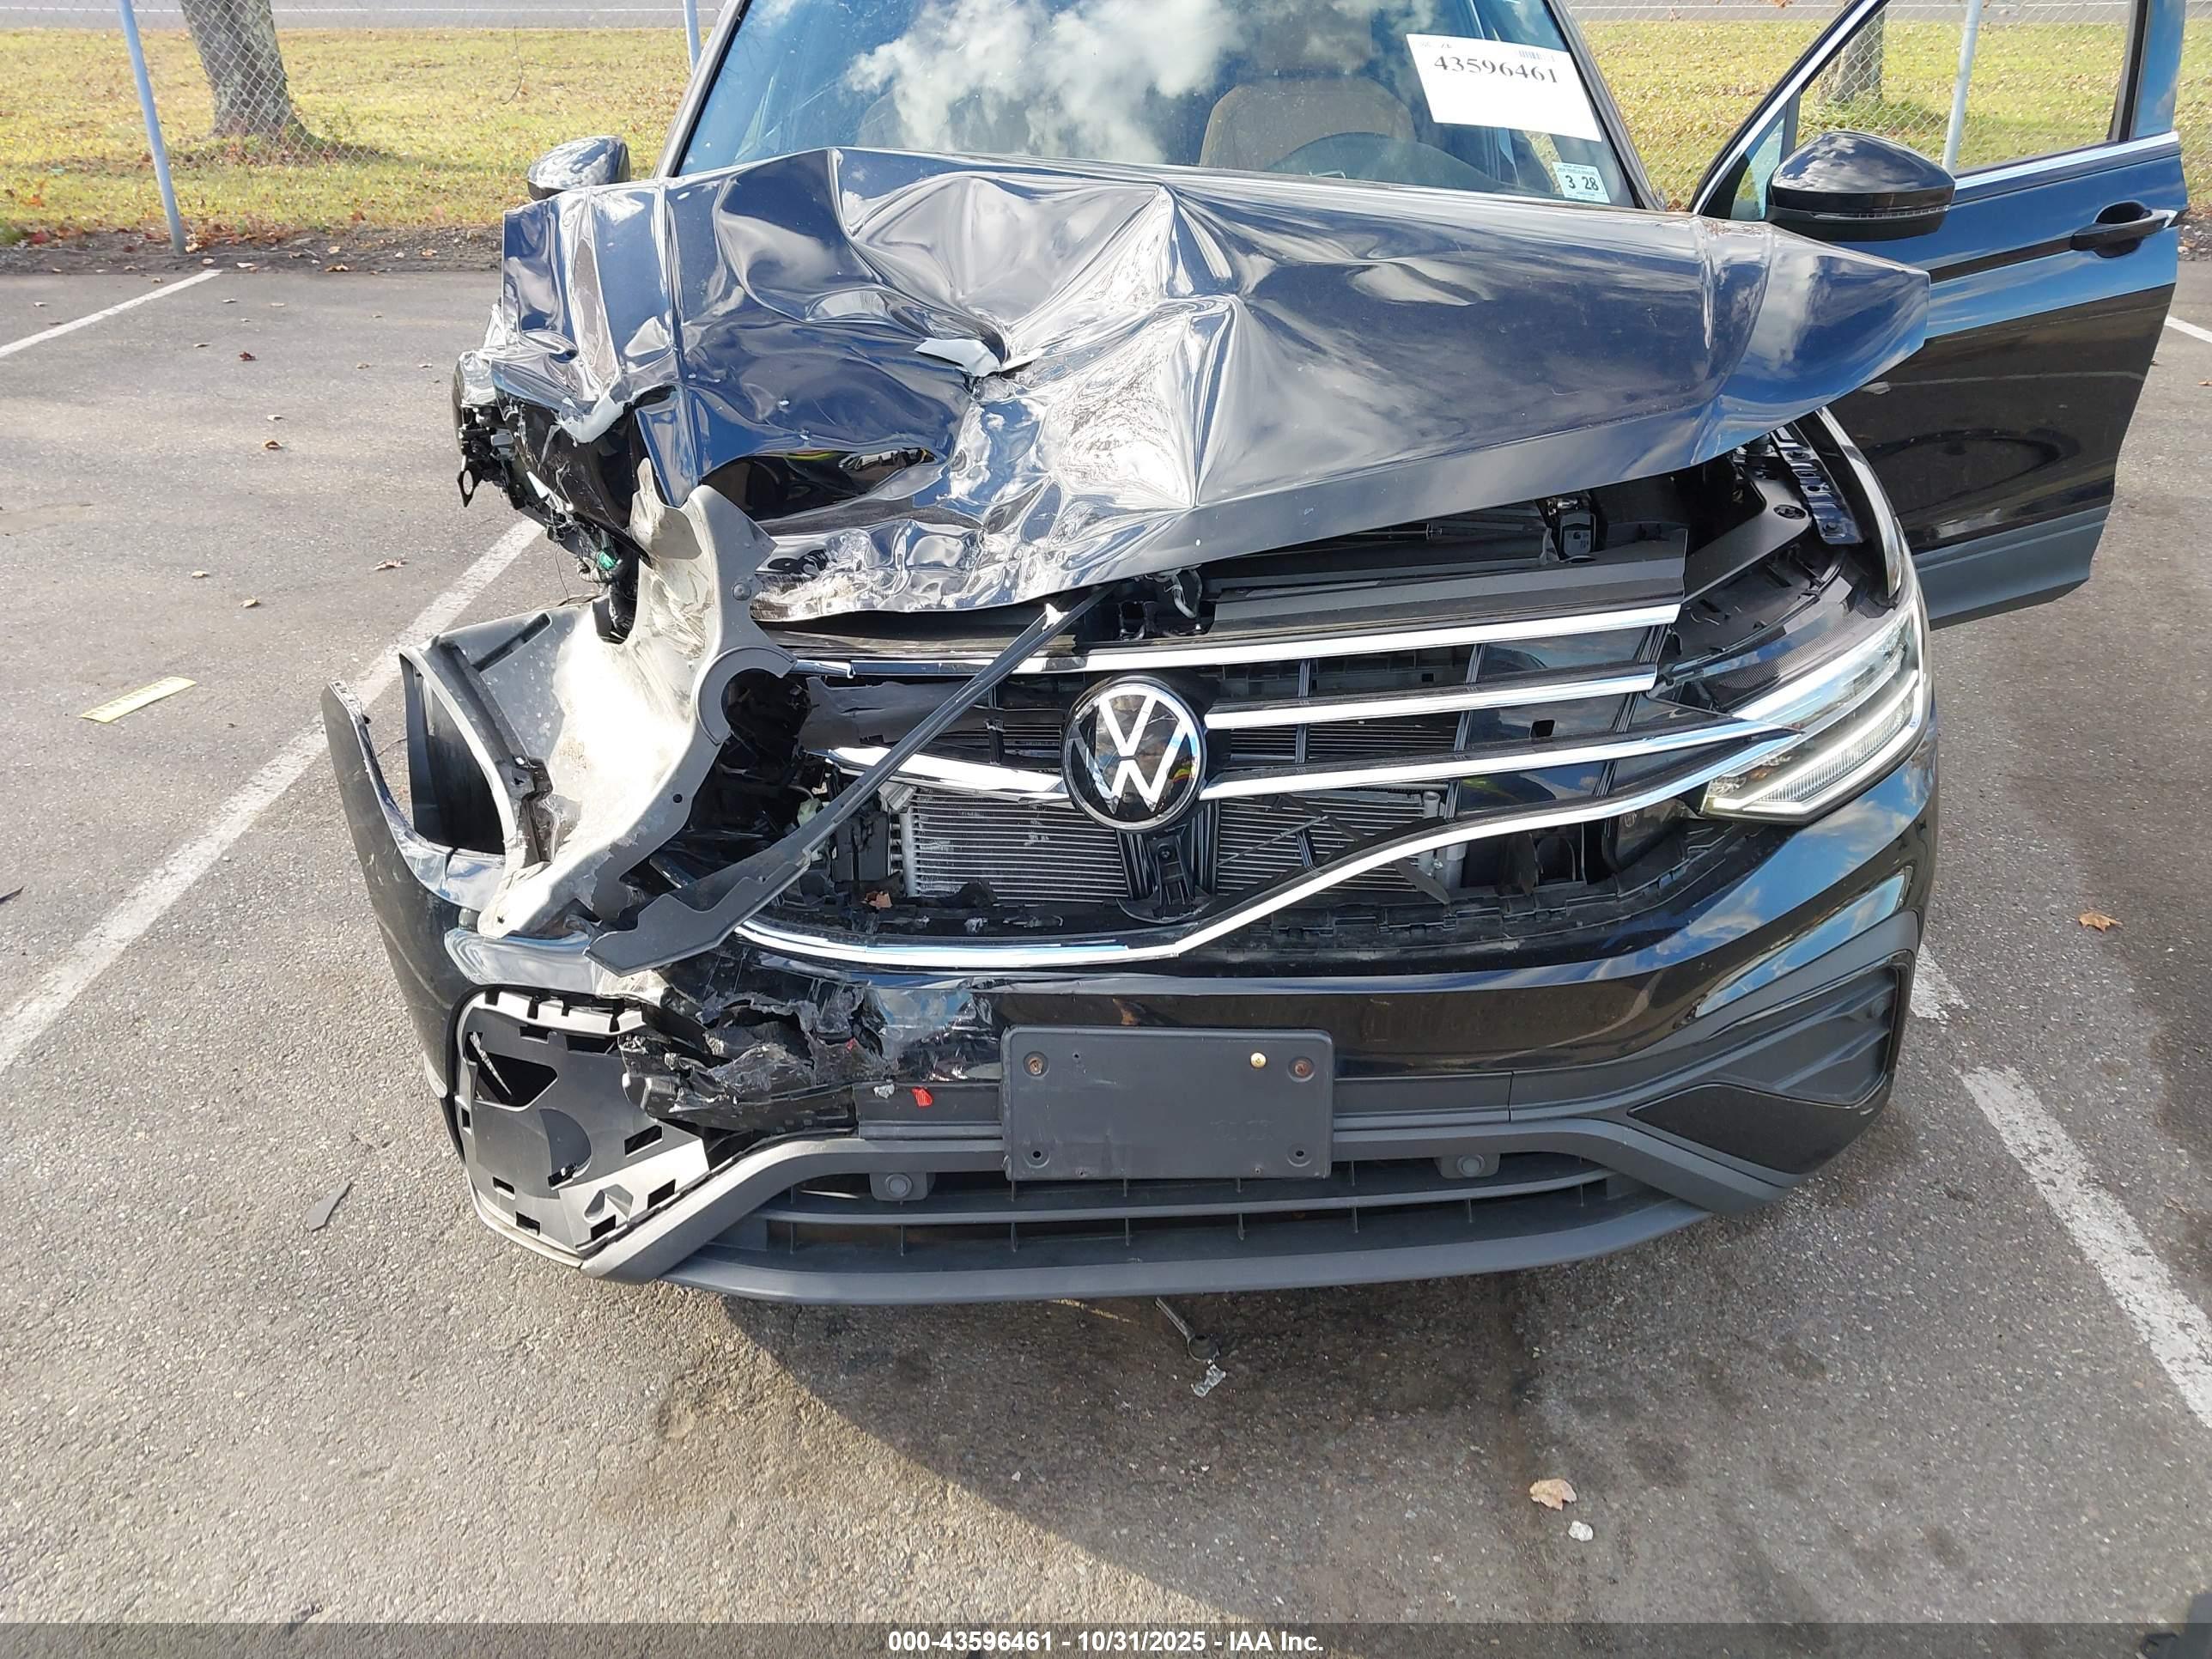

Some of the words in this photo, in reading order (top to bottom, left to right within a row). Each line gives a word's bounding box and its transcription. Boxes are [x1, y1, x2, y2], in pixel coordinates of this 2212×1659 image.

[1433, 55, 1559, 83] 43596461
[1565, 174, 1577, 190] 3
[1581, 176, 1600, 191] 28
